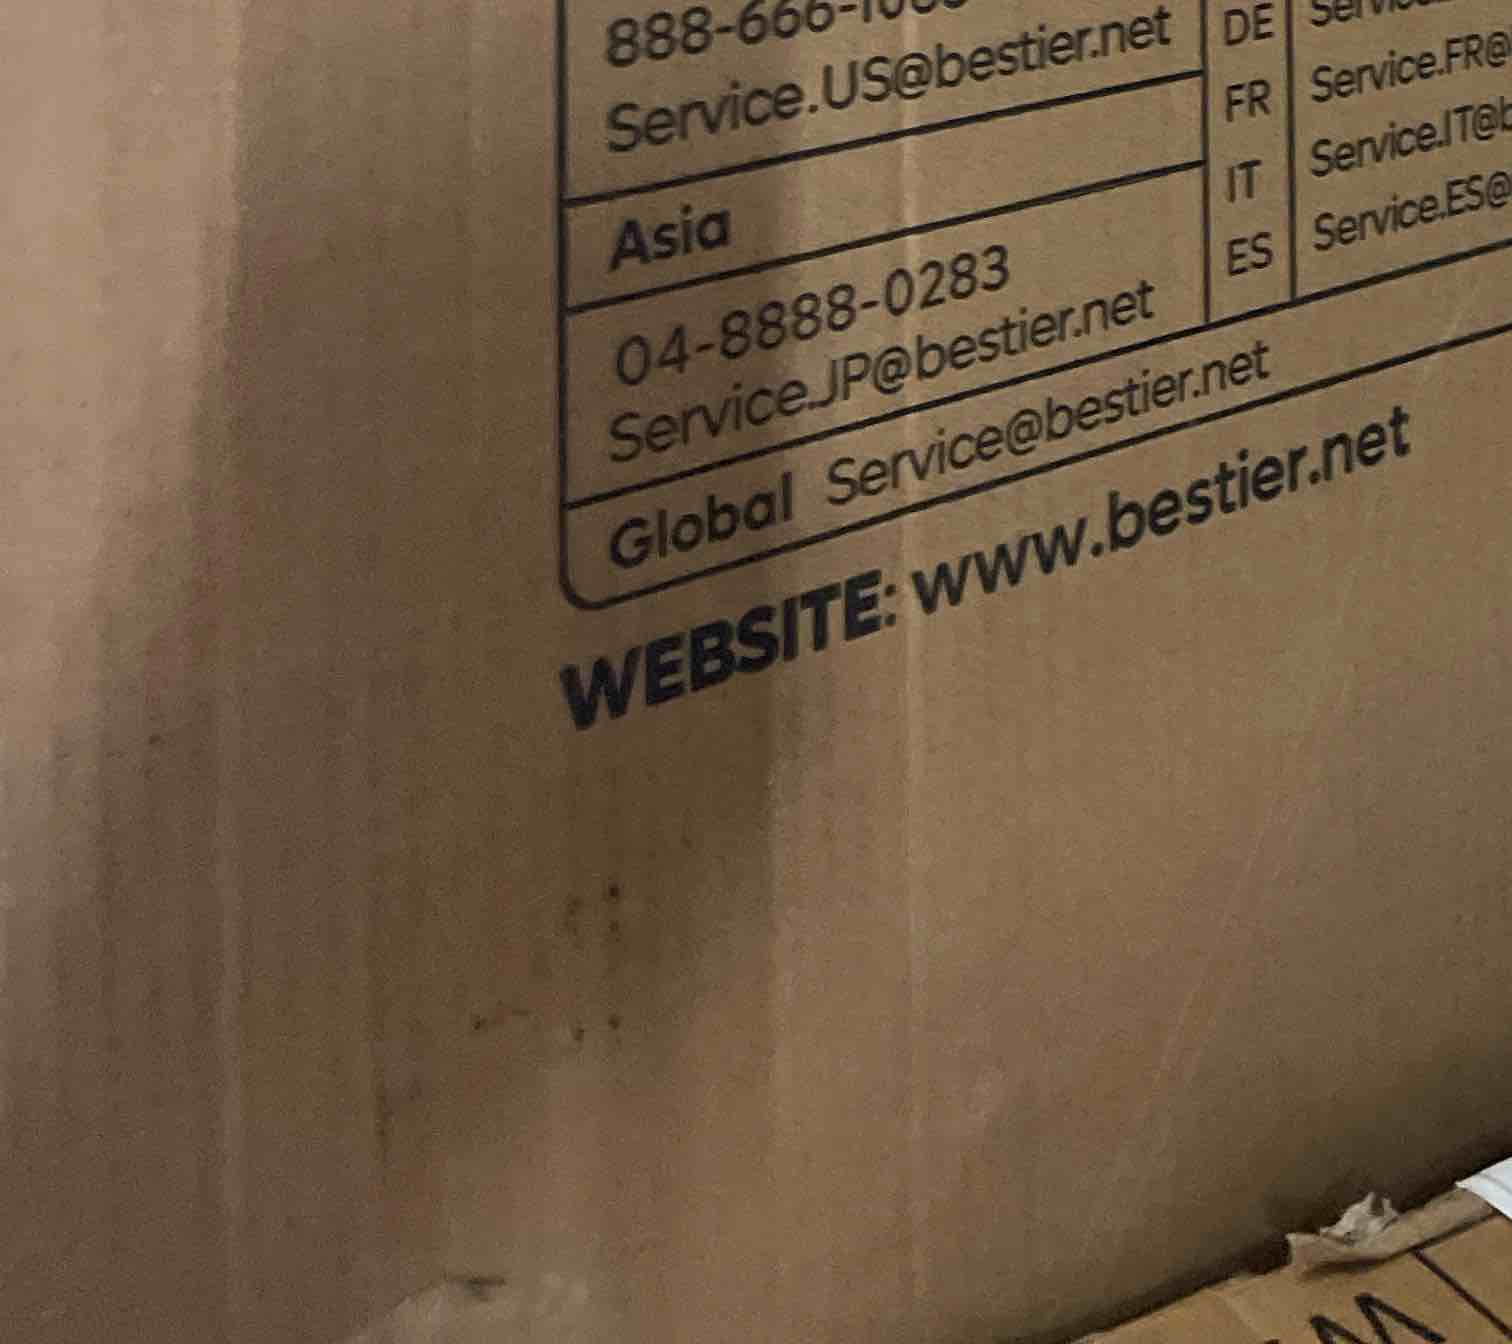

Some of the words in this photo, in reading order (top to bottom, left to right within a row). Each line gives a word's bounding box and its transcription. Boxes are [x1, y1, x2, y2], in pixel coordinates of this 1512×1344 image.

[1224, 3, 1274, 47] DE
[606, 6, 1172, 153] Service.US@bestier.net
[1225, 80, 1271, 123] FR
[1226, 160, 1262, 203] IT
[608, 204, 731, 272] Asia
[1226, 232, 1275, 278] ES
[615, 244, 1010, 386] 04-8888-0283
[609, 471, 793, 569] Global
[827, 340, 1271, 505] Service@bestier.net
[560, 568, 898, 731] WEBSITE:
[912, 406, 1412, 614] www.bestier.net
